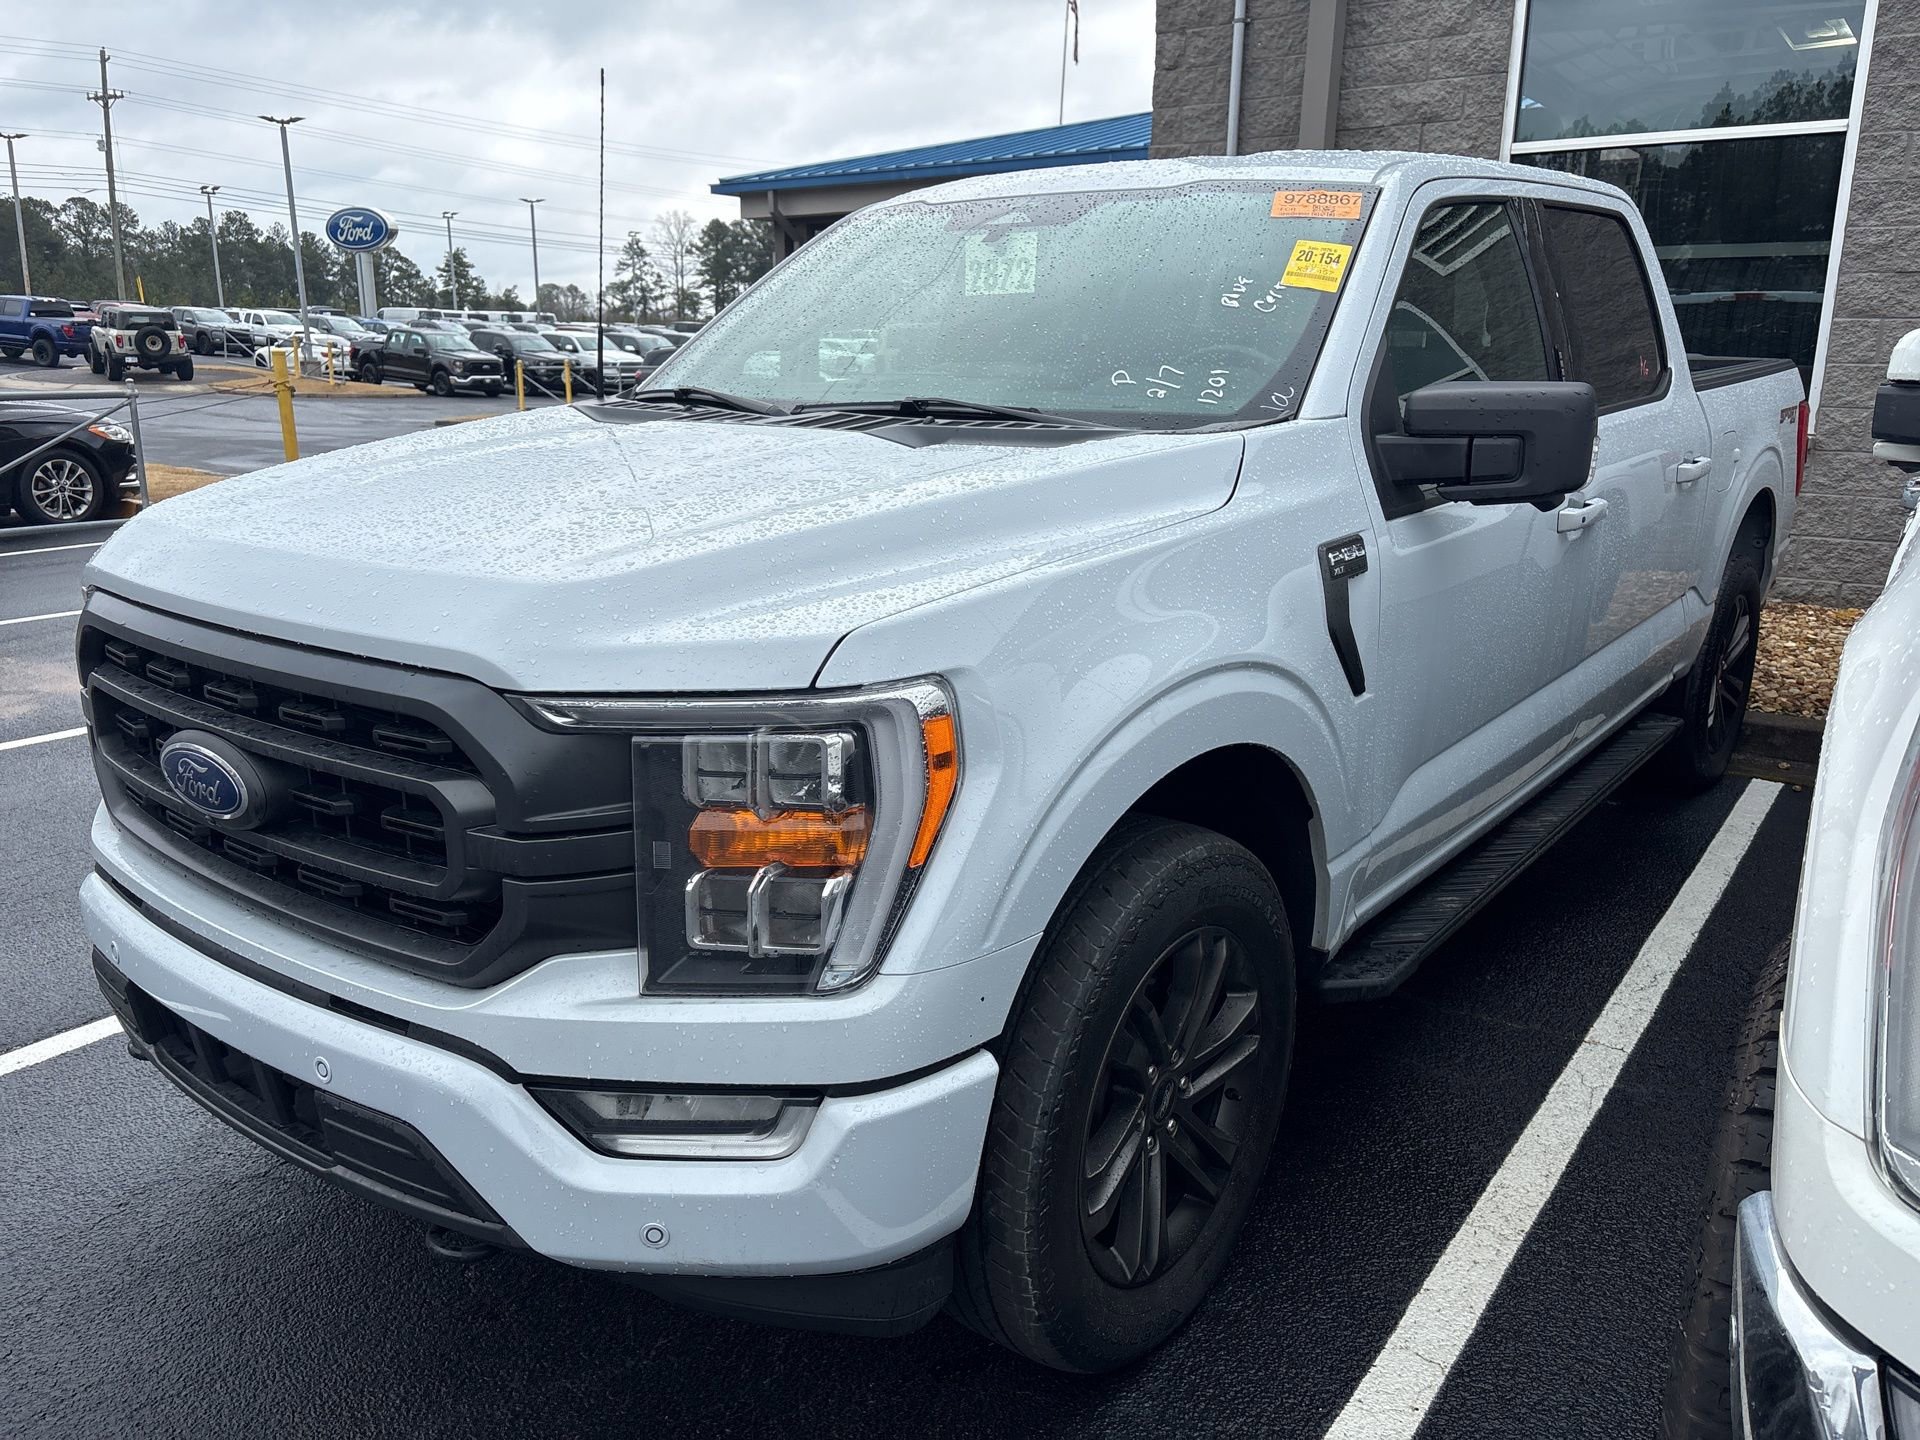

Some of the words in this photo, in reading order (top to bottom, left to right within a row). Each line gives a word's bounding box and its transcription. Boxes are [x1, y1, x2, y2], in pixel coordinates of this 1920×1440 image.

[1284, 193, 1361, 205] 9788867
[337, 215, 373, 242] Ford
[1296, 250, 1341, 265] 20:154
[175, 757, 221, 805] Ford
